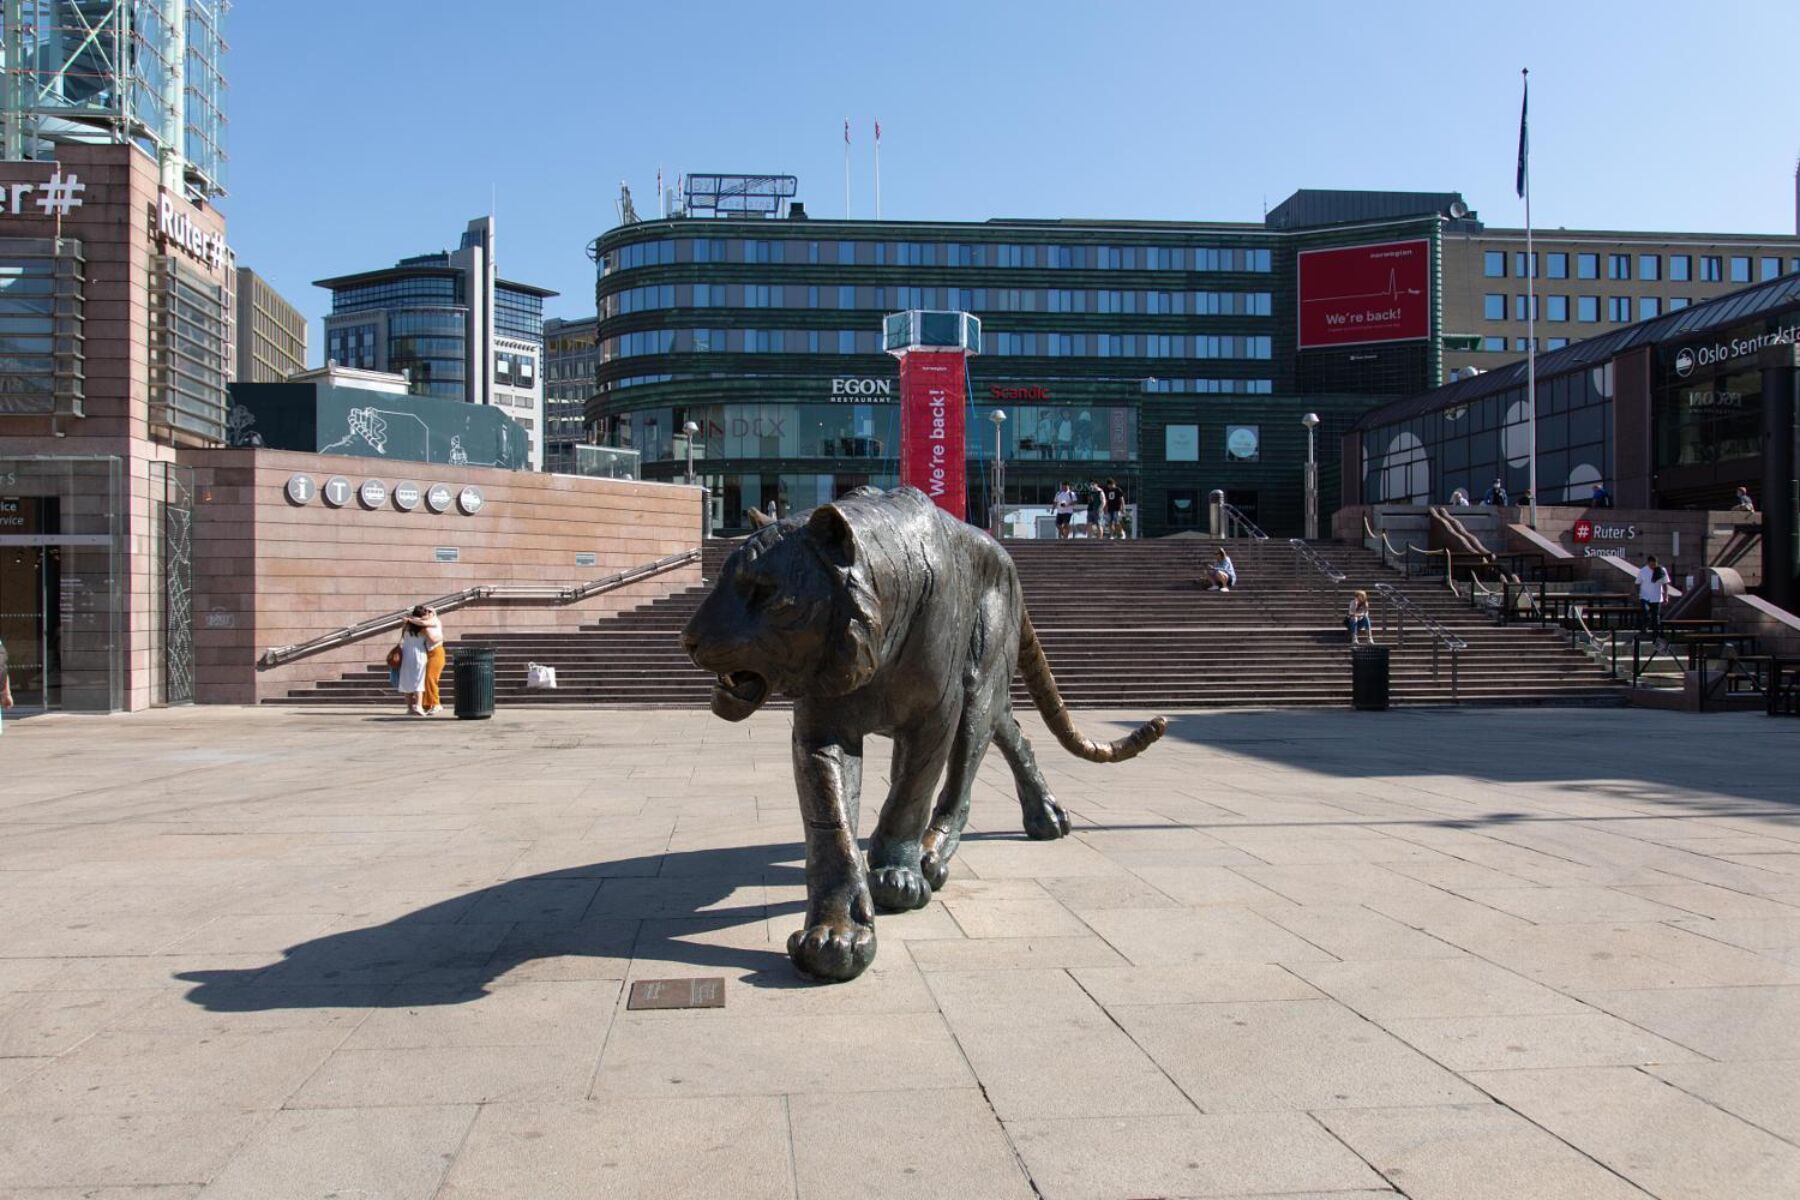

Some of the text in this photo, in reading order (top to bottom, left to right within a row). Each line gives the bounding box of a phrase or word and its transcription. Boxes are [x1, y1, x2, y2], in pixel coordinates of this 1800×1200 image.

[160, 192, 224, 269] Ruter#
[1366, 308, 1401, 321] back!
[1698, 342, 1728, 365] Oslo
[832, 379, 891, 394] EGON
[991, 384, 1050, 400] Scandic
[928, 389, 944, 496] We're back!
[1594, 525, 1625, 539] Ruter
[1627, 526, 1636, 540] S
